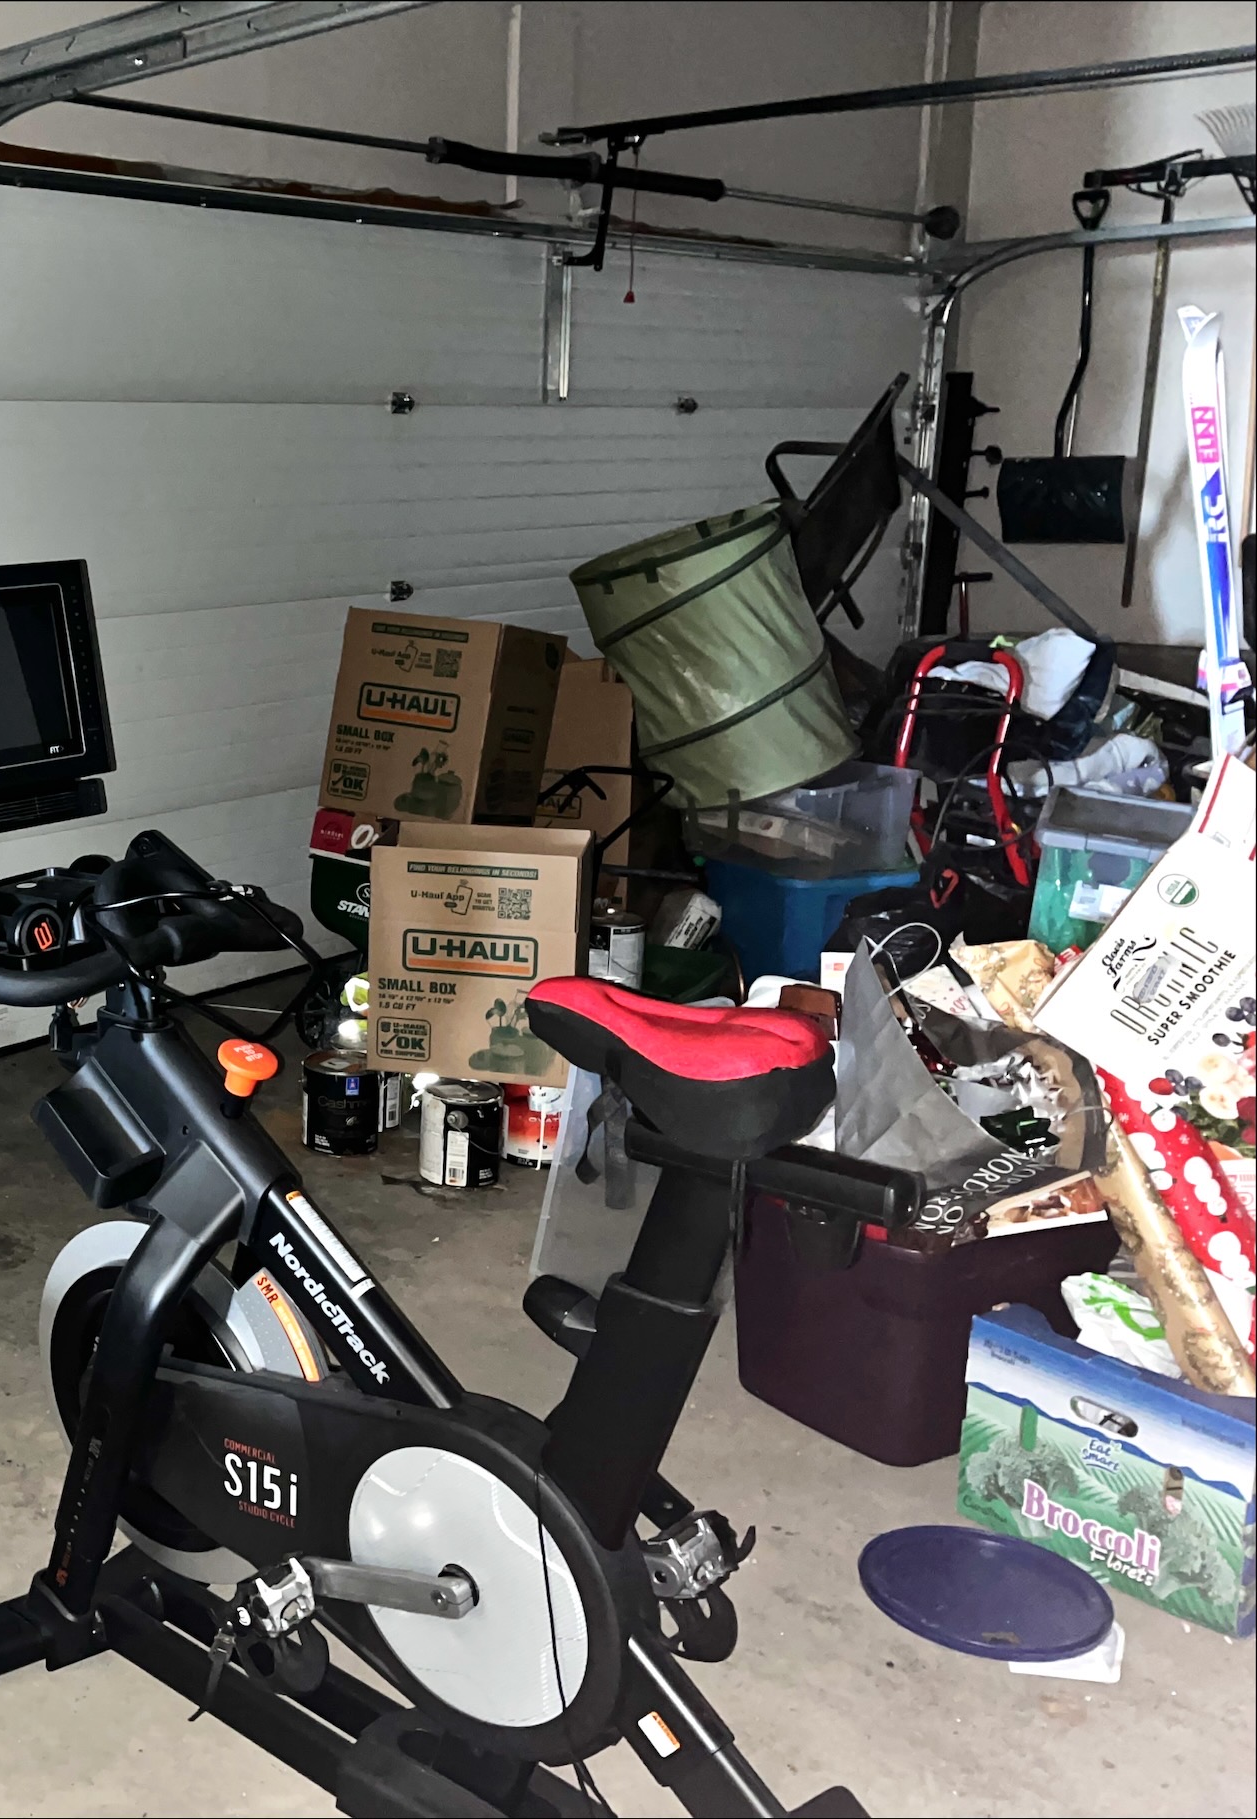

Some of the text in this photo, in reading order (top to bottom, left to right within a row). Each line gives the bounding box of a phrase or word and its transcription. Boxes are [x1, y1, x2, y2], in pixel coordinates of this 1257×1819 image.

[365, 689, 452, 717] U-HAUL
[336, 724, 395, 743] SMALL BOX
[337, 900, 369, 918] STAN
[410, 890, 465, 903] U-Haul App
[412, 936, 529, 963] U-HAUL
[1101, 938, 1125, 968] Clovis
[1106, 940, 1137, 978] Farms
[378, 977, 457, 995] SMALL BOX
[1147, 1010, 1184, 1045] SUPER
[1178, 950, 1237, 1010] SMOOTHIE
[396, 1036, 426, 1051] OK
[257, 1276, 279, 1304] SMR
[268, 1232, 390, 1385] NordicTrack
[224, 1437, 276, 1464] COMMERCIAL
[1082, 1449, 1120, 1471] Smart
[1088, 1439, 1112, 1457] Eat
[224, 1452, 298, 1517] S15i
[238, 1500, 295, 1528] STUDIO CYCLE
[1023, 1480, 1160, 1575] Broccoli
[1090, 1547, 1156, 1587] Florets
